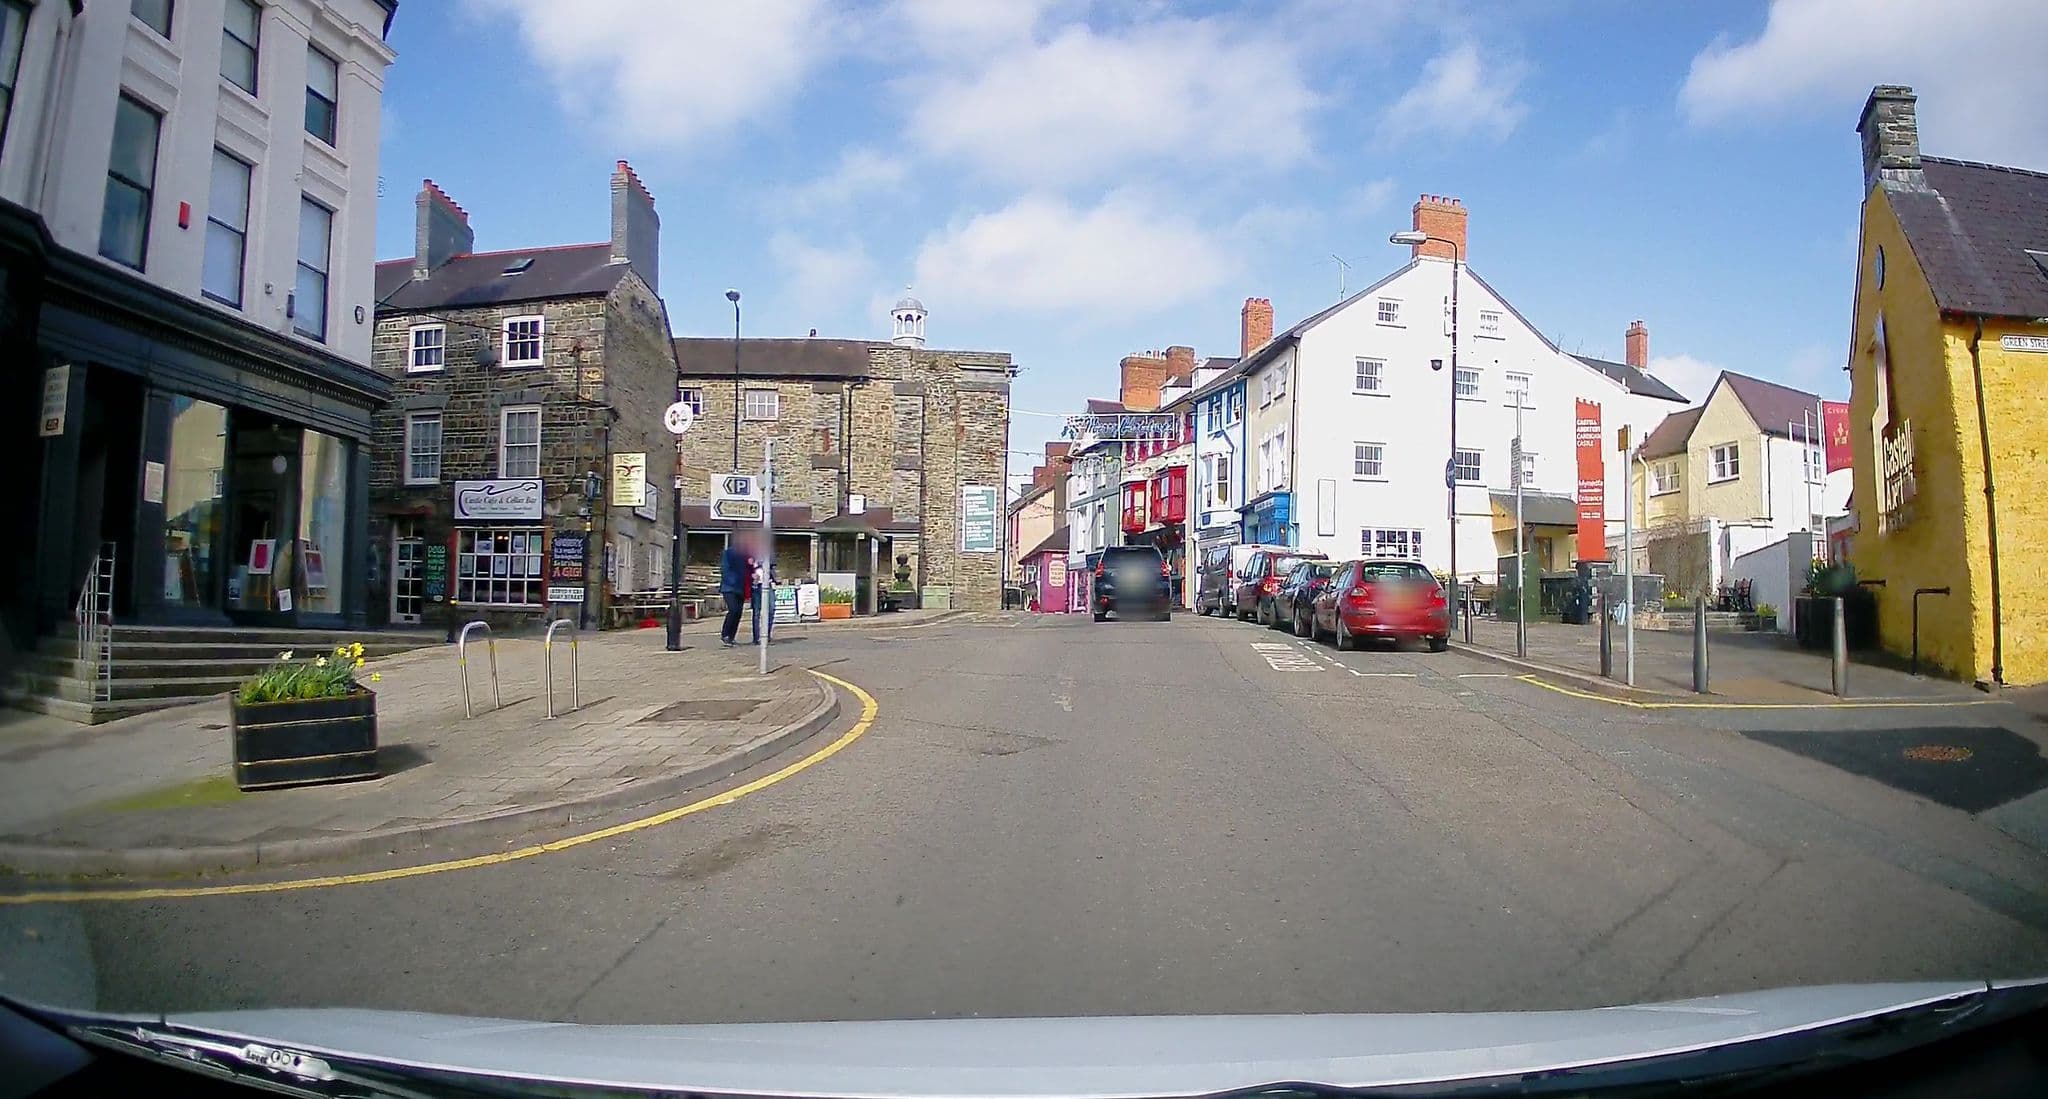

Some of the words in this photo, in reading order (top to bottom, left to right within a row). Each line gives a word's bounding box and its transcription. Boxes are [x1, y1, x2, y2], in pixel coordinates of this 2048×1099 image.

[2003, 336, 2028, 347] GREEN
[1883, 417, 1913, 479] Castell
[735, 480, 747, 493] P
